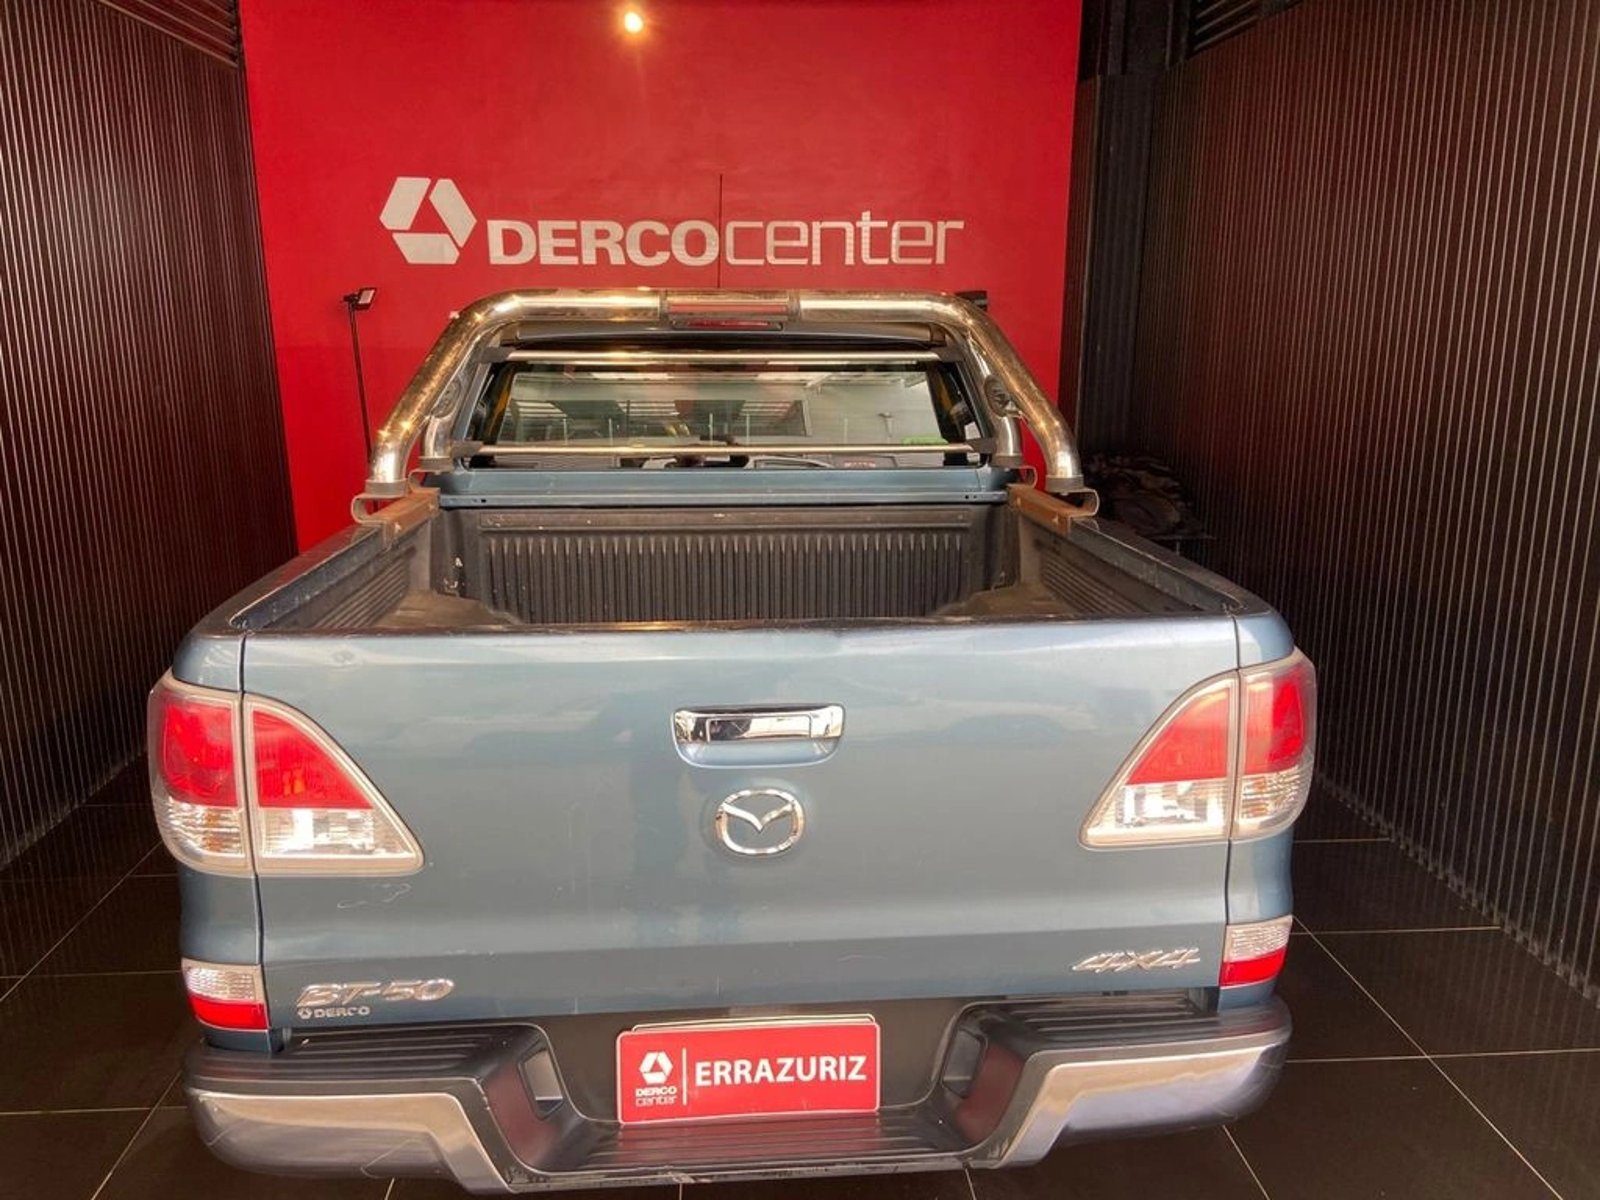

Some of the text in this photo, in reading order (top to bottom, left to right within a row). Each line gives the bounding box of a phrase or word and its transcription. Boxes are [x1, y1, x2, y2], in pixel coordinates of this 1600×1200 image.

[296, 978, 455, 1007] BT-50
[313, 1006, 371, 1018] DERCO
[695, 1055, 867, 1087] ERRAZURIZ
[635, 1085, 678, 1098] DERCO
[635, 1096, 678, 1108] center
